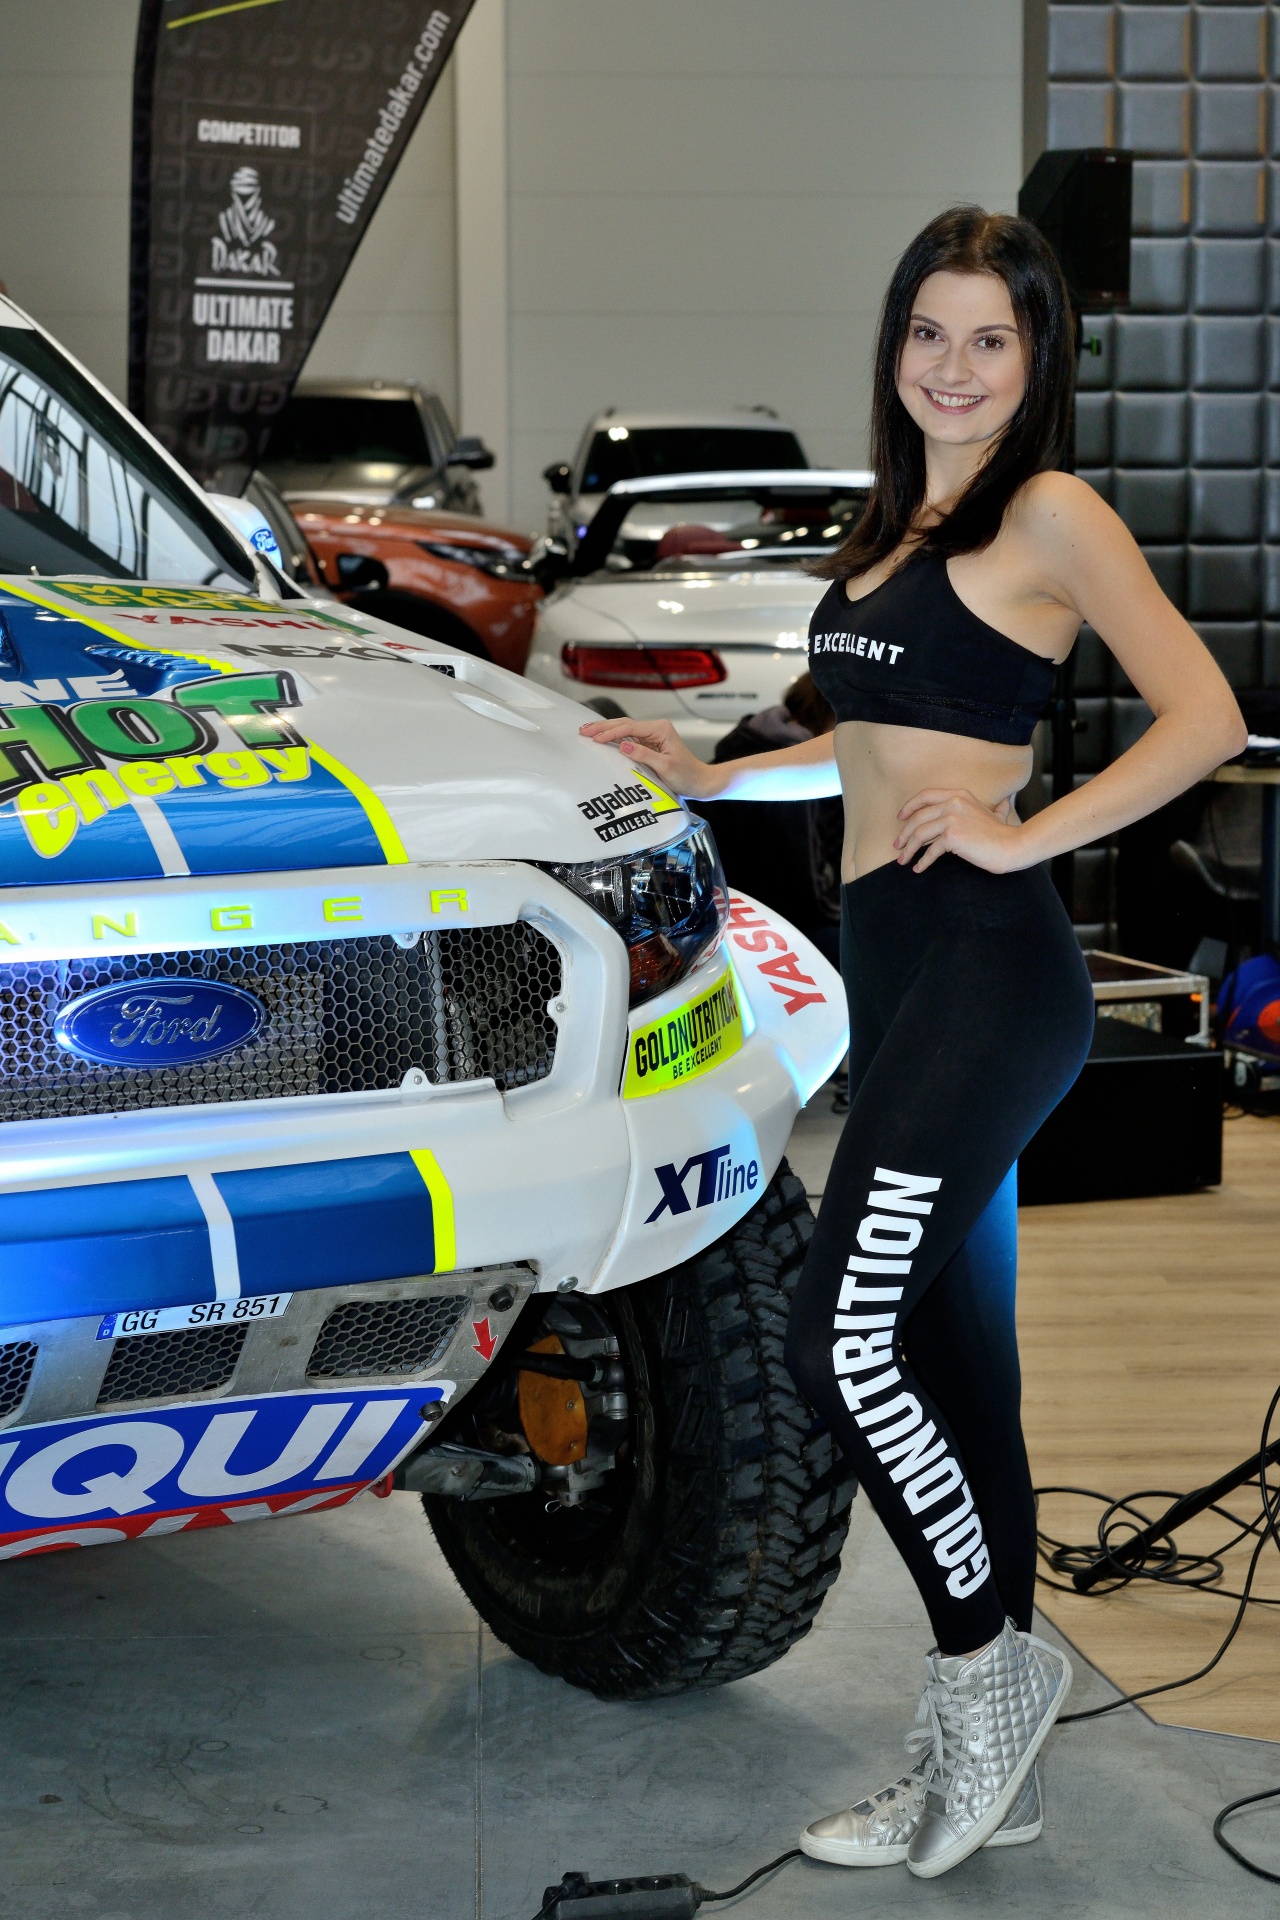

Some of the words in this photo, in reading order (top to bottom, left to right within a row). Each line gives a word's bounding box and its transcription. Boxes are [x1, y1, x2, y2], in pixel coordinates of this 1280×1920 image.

[197, 118, 301, 149] COMPETITOR
[336, 9, 450, 225] ultimatedakar.com
[193, 293, 294, 330] ULTIMATE
[206, 331, 281, 364] DAKAR
[813, 632, 905, 665] EXCELLENT
[17, 746, 311, 859] energy
[576, 783, 653, 821] agados
[598, 811, 657, 842] TRAILERS
[109, 994, 224, 1048] Ford
[634, 979, 739, 1078] GOLDNUTRITION
[672, 1061, 684, 1080] BE
[686, 1035, 723, 1073] EXCELLENT
[643, 1143, 760, 1225] XTline
[122, 1308, 159, 1333] GG
[188, 1302, 227, 1324] SR
[232, 1296, 281, 1319] 851
[831, 1166, 992, 1600] GOLDNUTRITION
[0, 1398, 410, 1518] QUI
